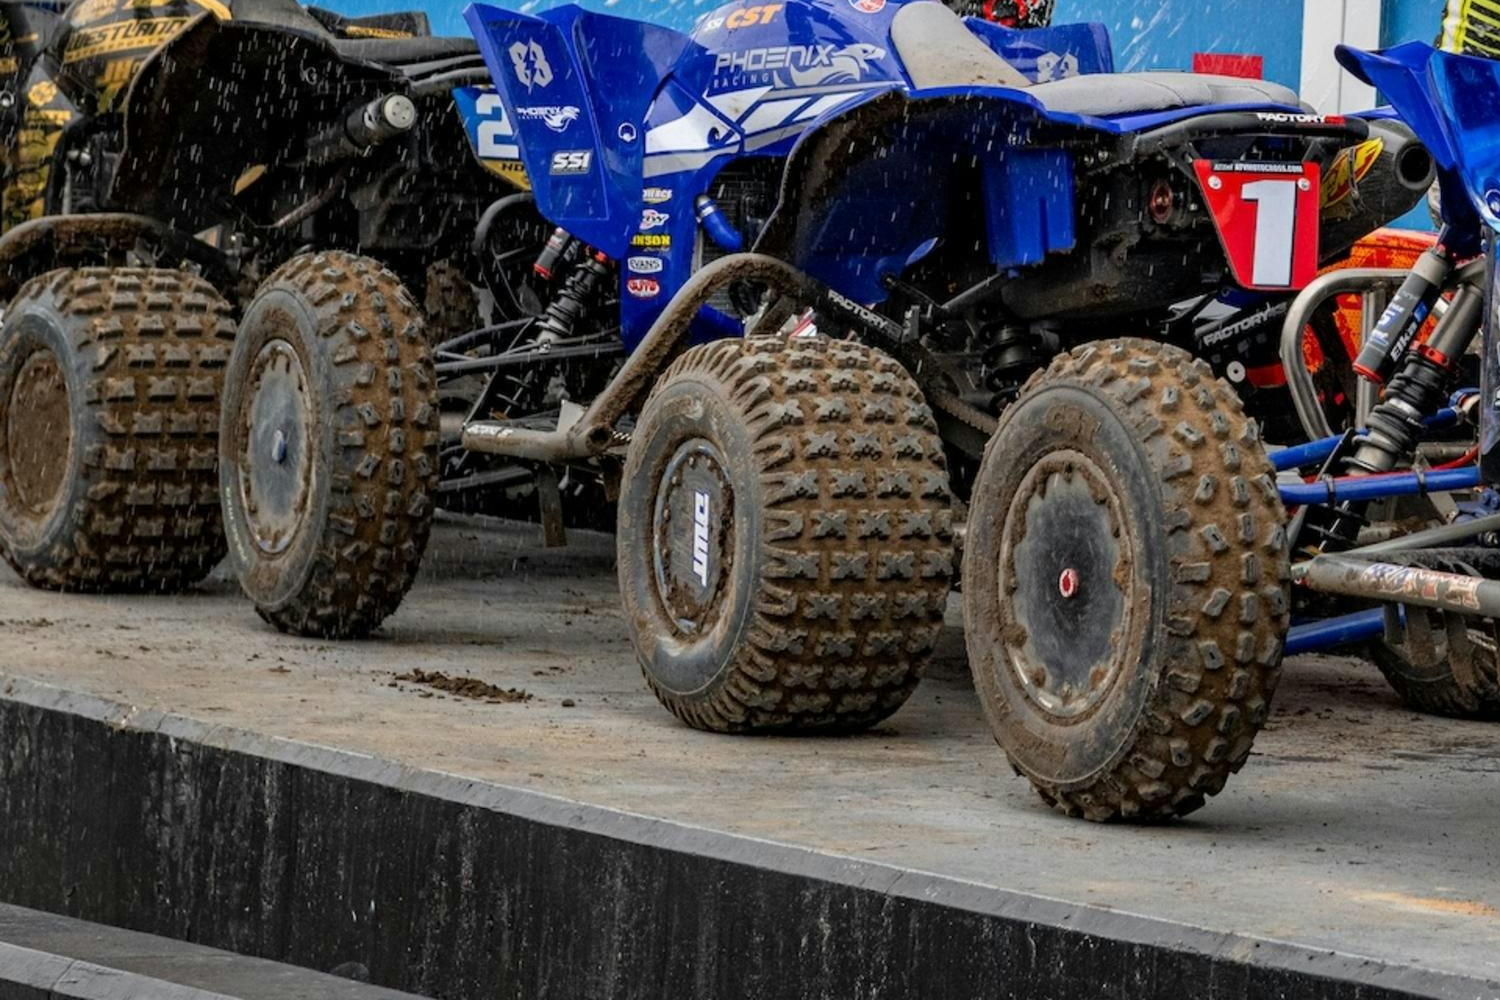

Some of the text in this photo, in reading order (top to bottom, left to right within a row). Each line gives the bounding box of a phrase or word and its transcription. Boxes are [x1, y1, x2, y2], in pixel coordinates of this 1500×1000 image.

[725, 4, 783, 29] CST
[714, 44, 837, 75] PHOENIX
[713, 72, 769, 88] RACING
[552, 152, 590, 169] SSI
[632, 235, 671, 246] INSON
[1241, 179, 1297, 287] 1
